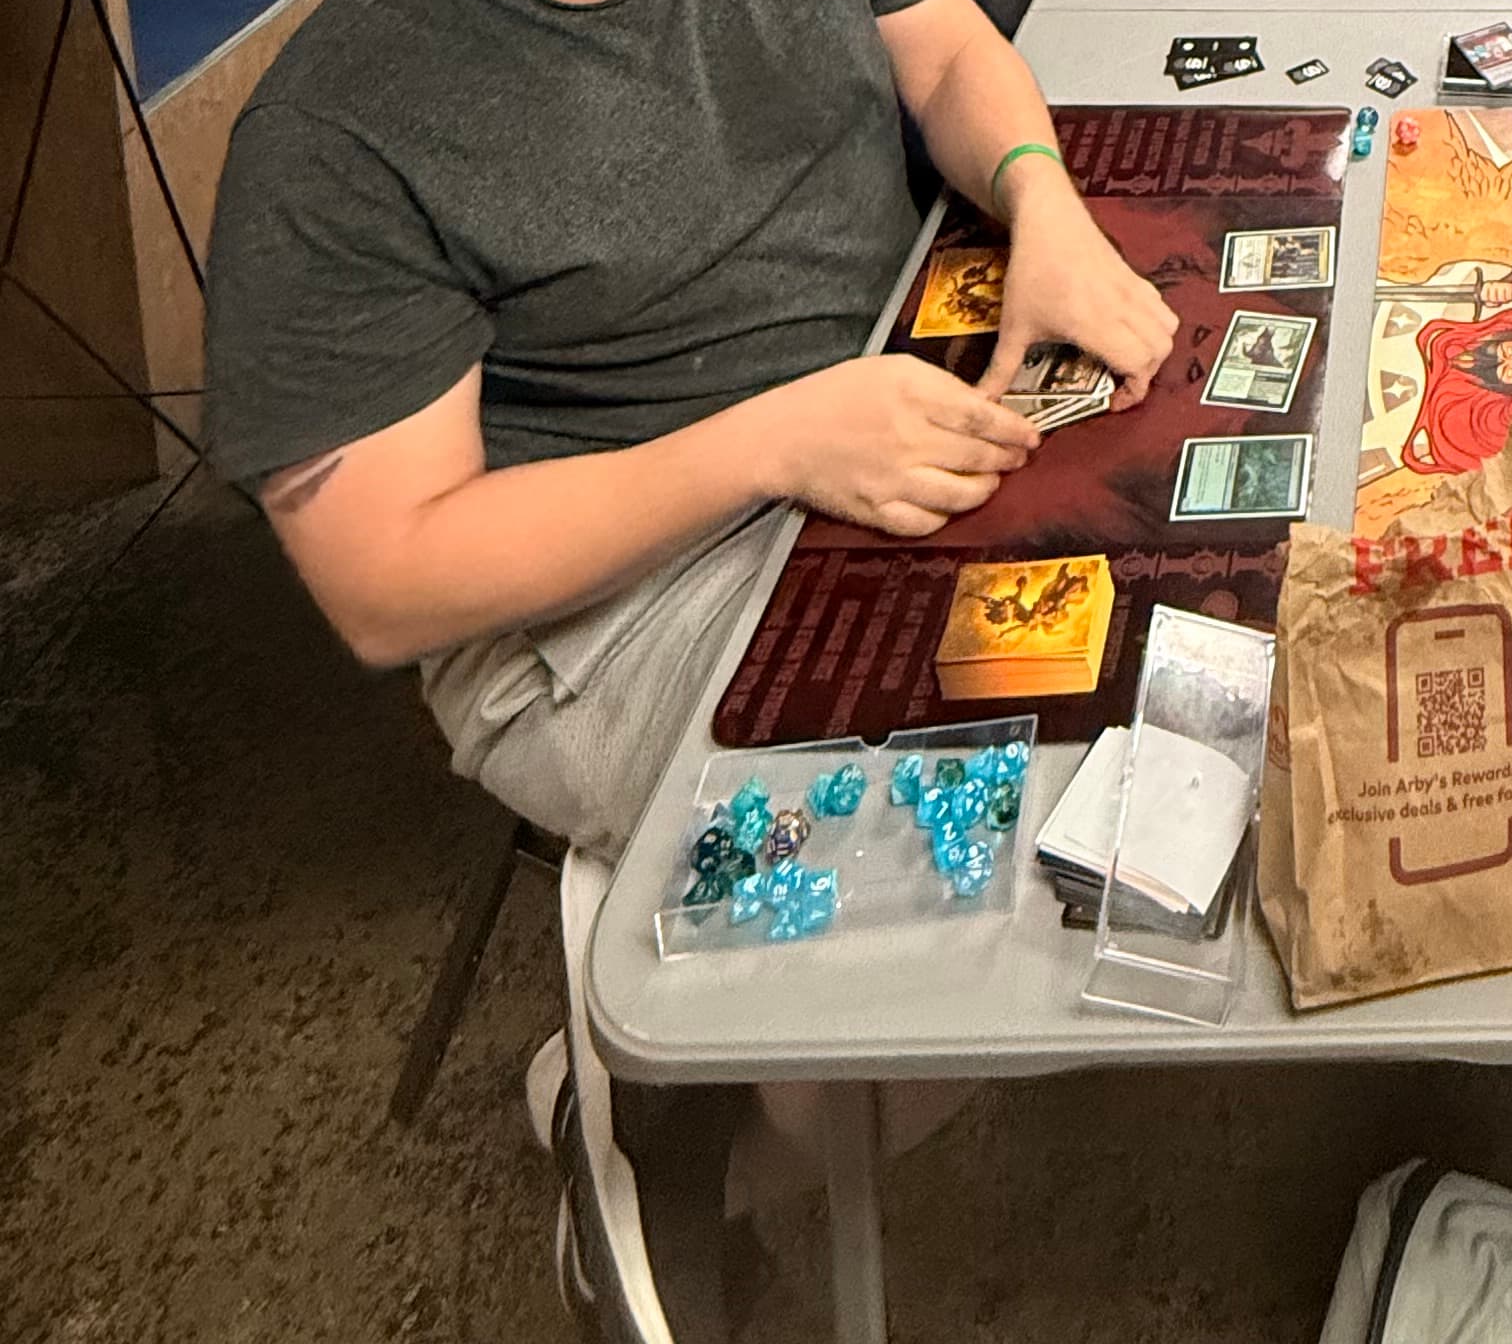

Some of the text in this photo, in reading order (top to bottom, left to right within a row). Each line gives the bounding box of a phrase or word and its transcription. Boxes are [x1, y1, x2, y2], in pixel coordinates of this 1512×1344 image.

[1358, 780, 1391, 799] Join
[1395, 771, 1448, 795] Arby's
[1327, 805, 1396, 825] exclusive
[1400, 798, 1442, 819] deals
[1446, 796, 1459, 812] &
[1462, 791, 1494, 810] free
